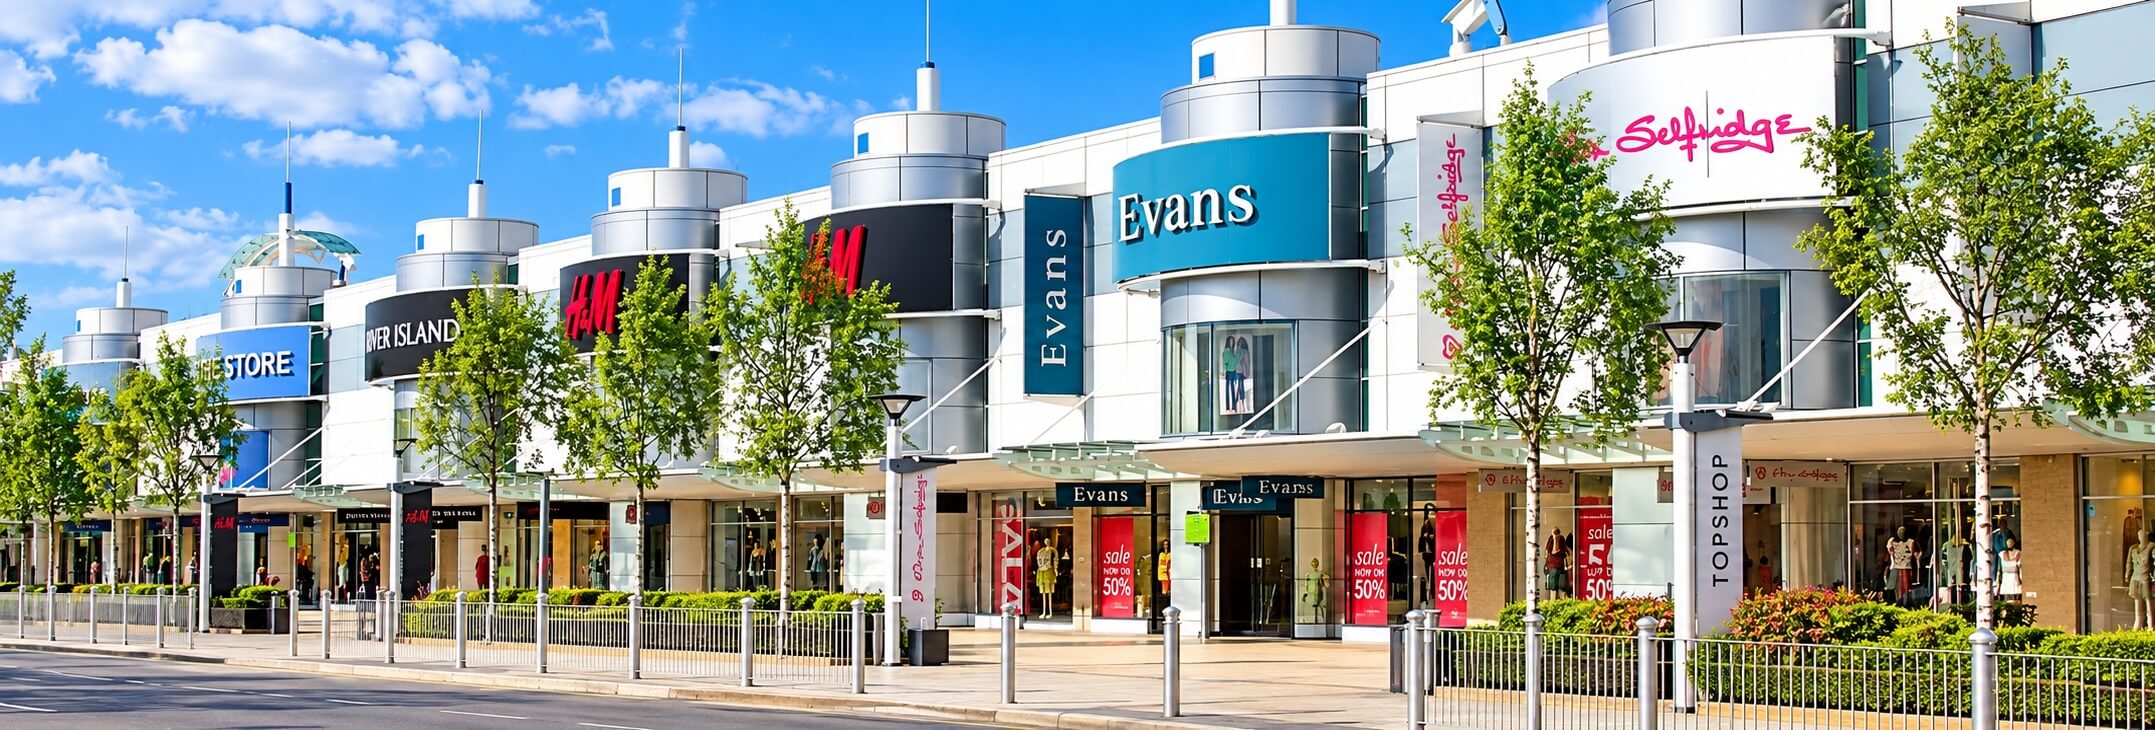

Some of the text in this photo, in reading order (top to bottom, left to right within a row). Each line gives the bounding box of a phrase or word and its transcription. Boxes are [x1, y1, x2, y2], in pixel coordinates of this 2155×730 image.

[1616, 106, 1811, 162] Selfridge
[1118, 184, 1258, 244] Evans
[565, 268, 625, 340] H&M
[1041, 229, 1067, 368] Evans
[394, 318, 461, 348] ISLAND
[224, 351, 293, 379] STORE
[1074, 486, 1129, 502] Evans
[1587, 523, 1613, 539] sale
[1712, 454, 1729, 588] TOPSHOP
[1103, 543, 1131, 564] sale
[1354, 543, 1384, 565] sale
[1438, 543, 1468, 565] sale
[1103, 577, 1131, 596] 50%
[1354, 579, 1385, 600] 50%
